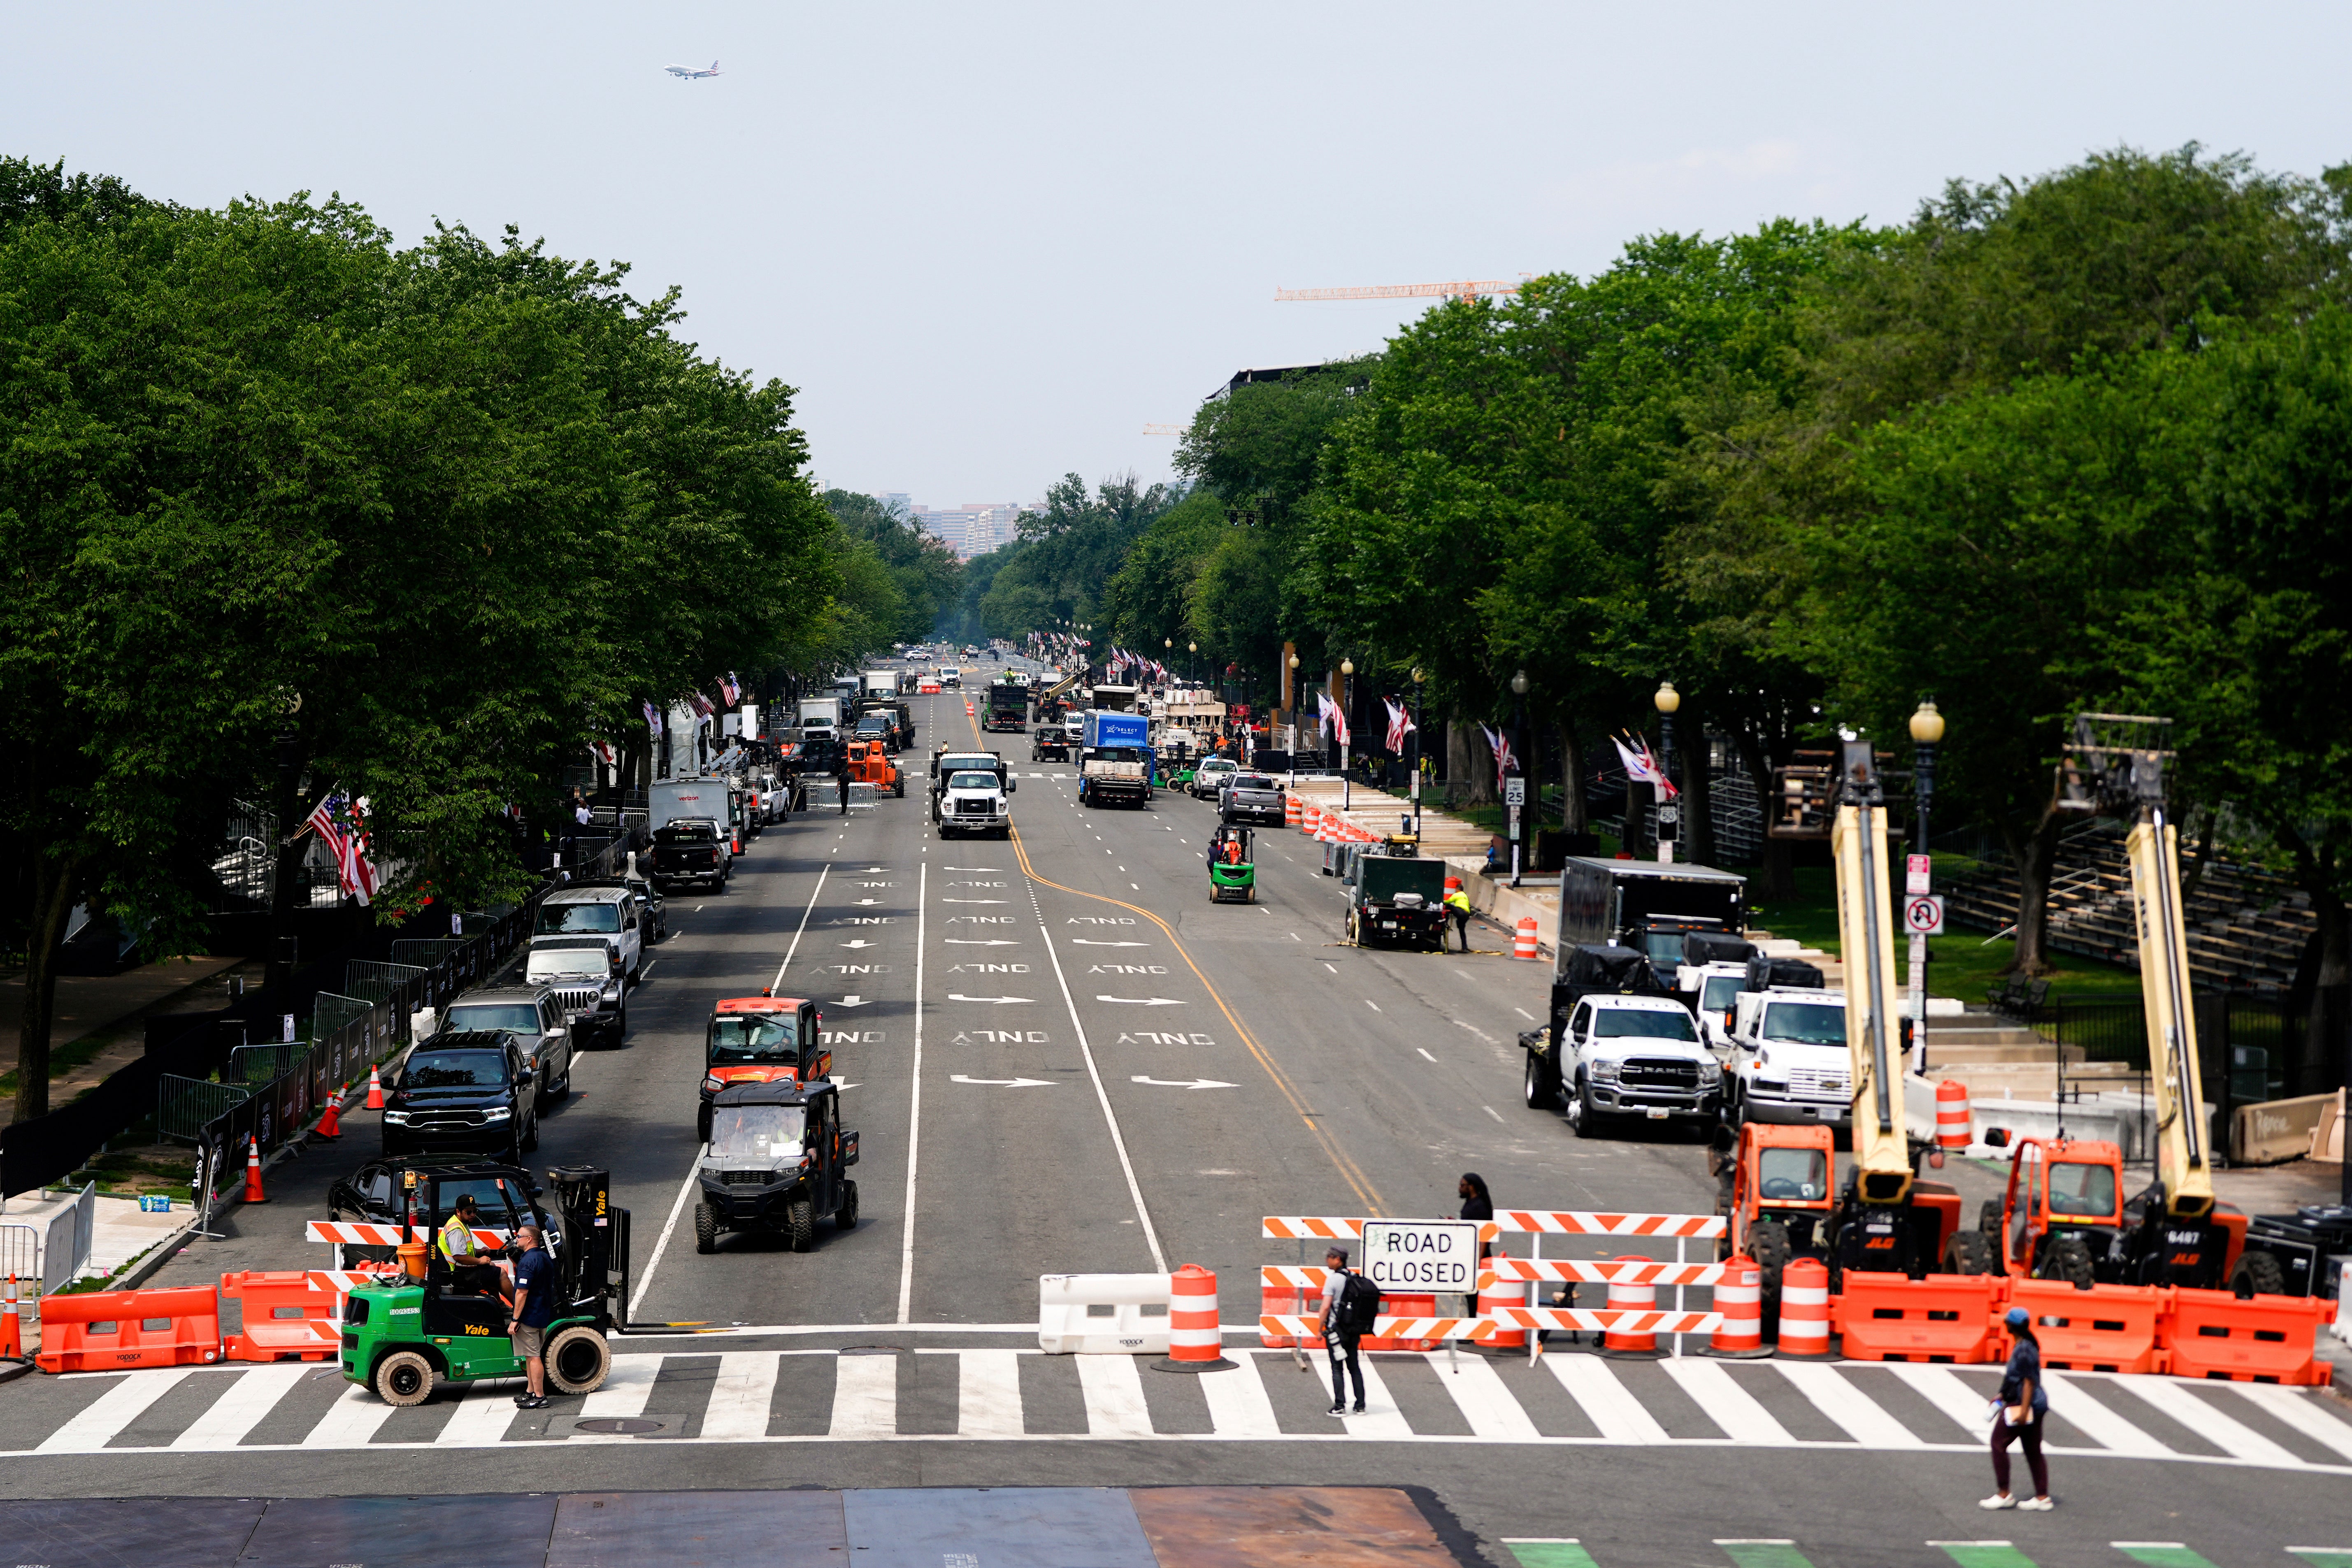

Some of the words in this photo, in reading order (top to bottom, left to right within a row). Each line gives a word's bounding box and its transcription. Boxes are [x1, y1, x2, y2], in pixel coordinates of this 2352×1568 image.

[1508, 792, 1522, 802] 25
[1662, 812, 1673, 820] 50
[809, 965, 893, 974] ONLY
[946, 964, 1031, 973] ONLY
[1087, 965, 1169, 974] ONLY
[818, 1031, 885, 1043] ONL
[950, 1031, 1050, 1043] ONLY
[1116, 1032, 1216, 1045] ONLY
[596, 1190, 606, 1216] Yale
[542, 1230, 556, 1259] 10093453
[1388, 1232, 1452, 1253] ROAD
[1865, 1237, 1896, 1248] JLG
[2170, 1253, 2200, 1265] JLG
[1373, 1262, 1465, 1283] CLOSED
[465, 1324, 489, 1336] Yale
[116, 1352, 142, 1361] YODOCK
